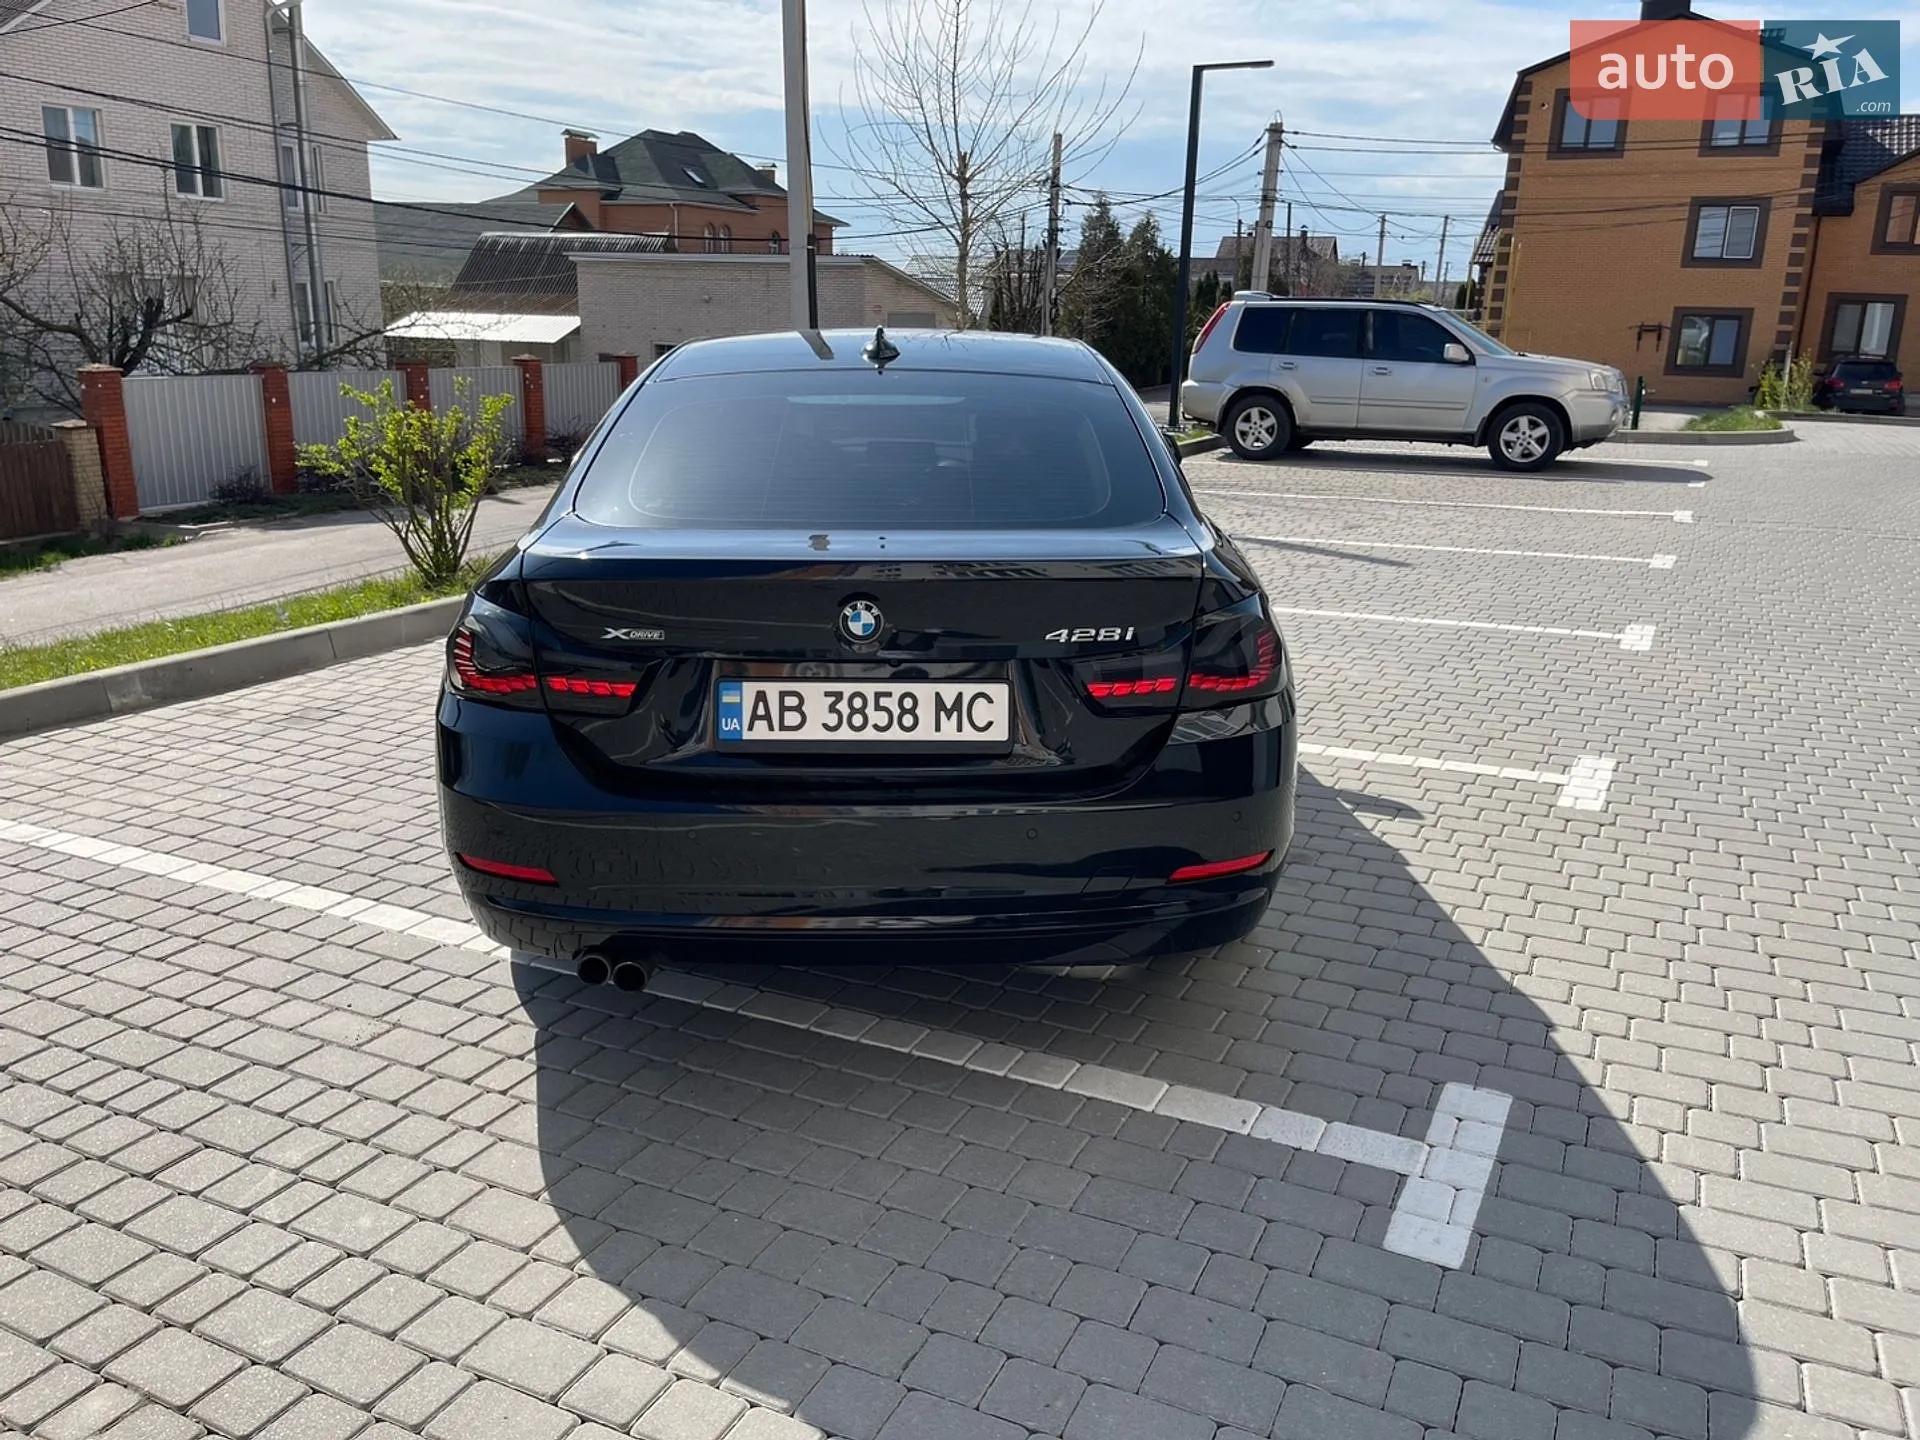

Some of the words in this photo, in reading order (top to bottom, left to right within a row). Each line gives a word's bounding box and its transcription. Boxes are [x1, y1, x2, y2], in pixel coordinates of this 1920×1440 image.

[1045, 626, 1135, 643] 428i
[747, 690, 808, 732] AB
[821, 690, 920, 733] 3858
[933, 691, 995, 733] MC
[722, 717, 741, 731] UA
